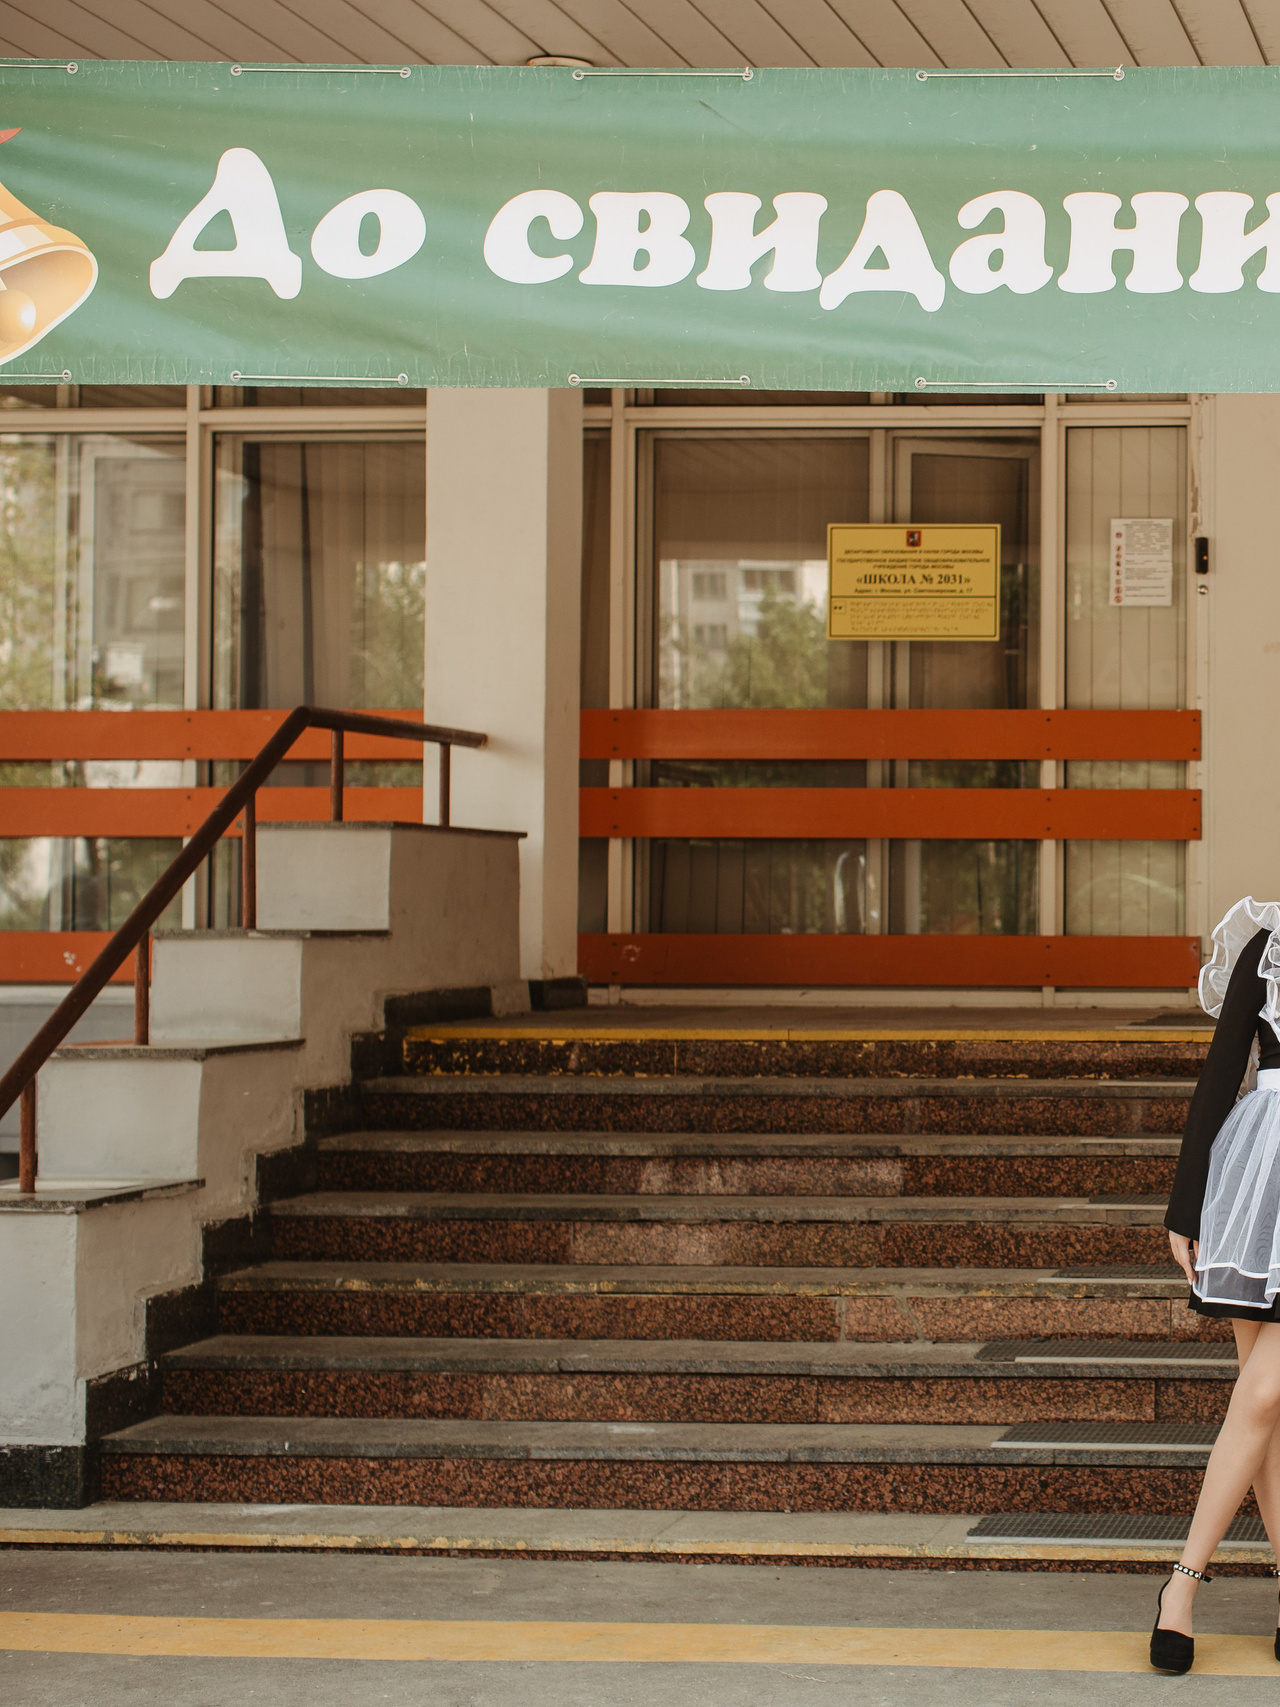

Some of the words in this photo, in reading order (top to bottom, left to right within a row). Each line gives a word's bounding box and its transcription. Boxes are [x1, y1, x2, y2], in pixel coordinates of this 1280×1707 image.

[149, 147, 428, 301] До
[856, 573, 915, 585] «ШКОЛА
[919, 573, 934, 585] №
[937, 573, 971, 585] 2031»
